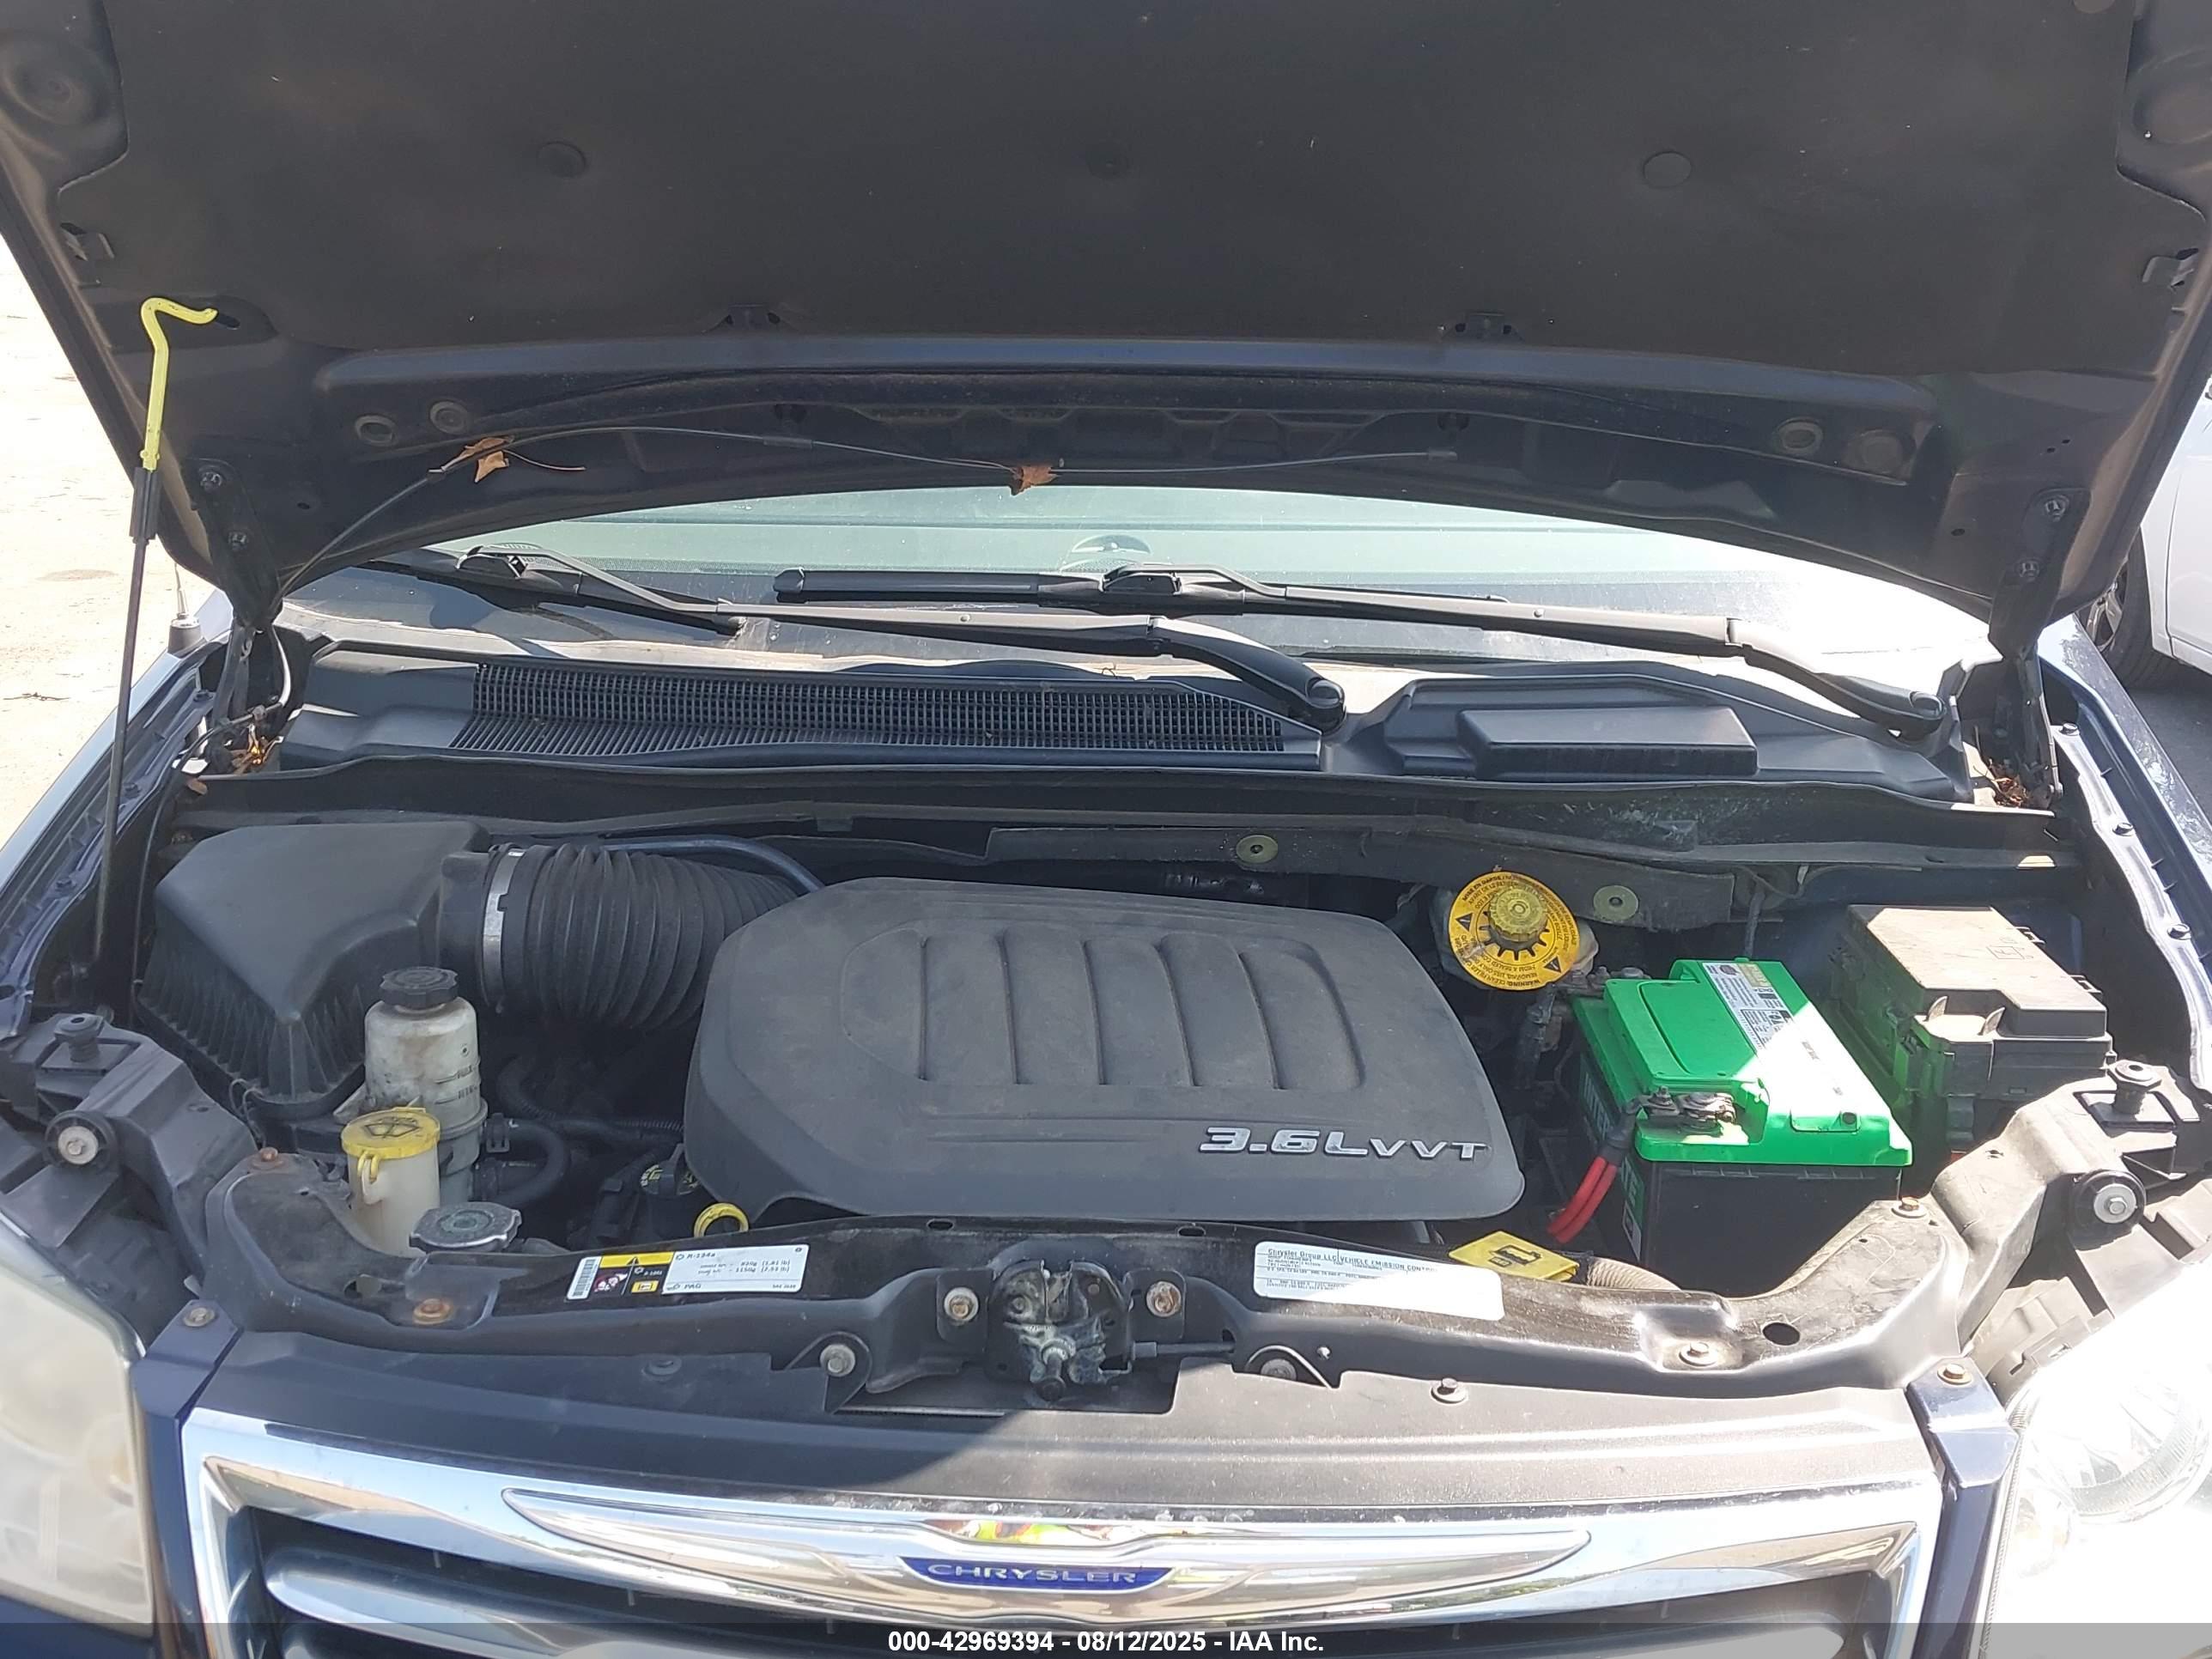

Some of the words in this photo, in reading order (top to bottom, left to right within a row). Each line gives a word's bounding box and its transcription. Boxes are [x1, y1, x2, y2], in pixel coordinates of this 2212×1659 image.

[1200, 1127, 1369, 1156] 3.6L
[1370, 1138, 1488, 1159] VVT
[927, 1565, 1137, 1583] CHRYSLER
